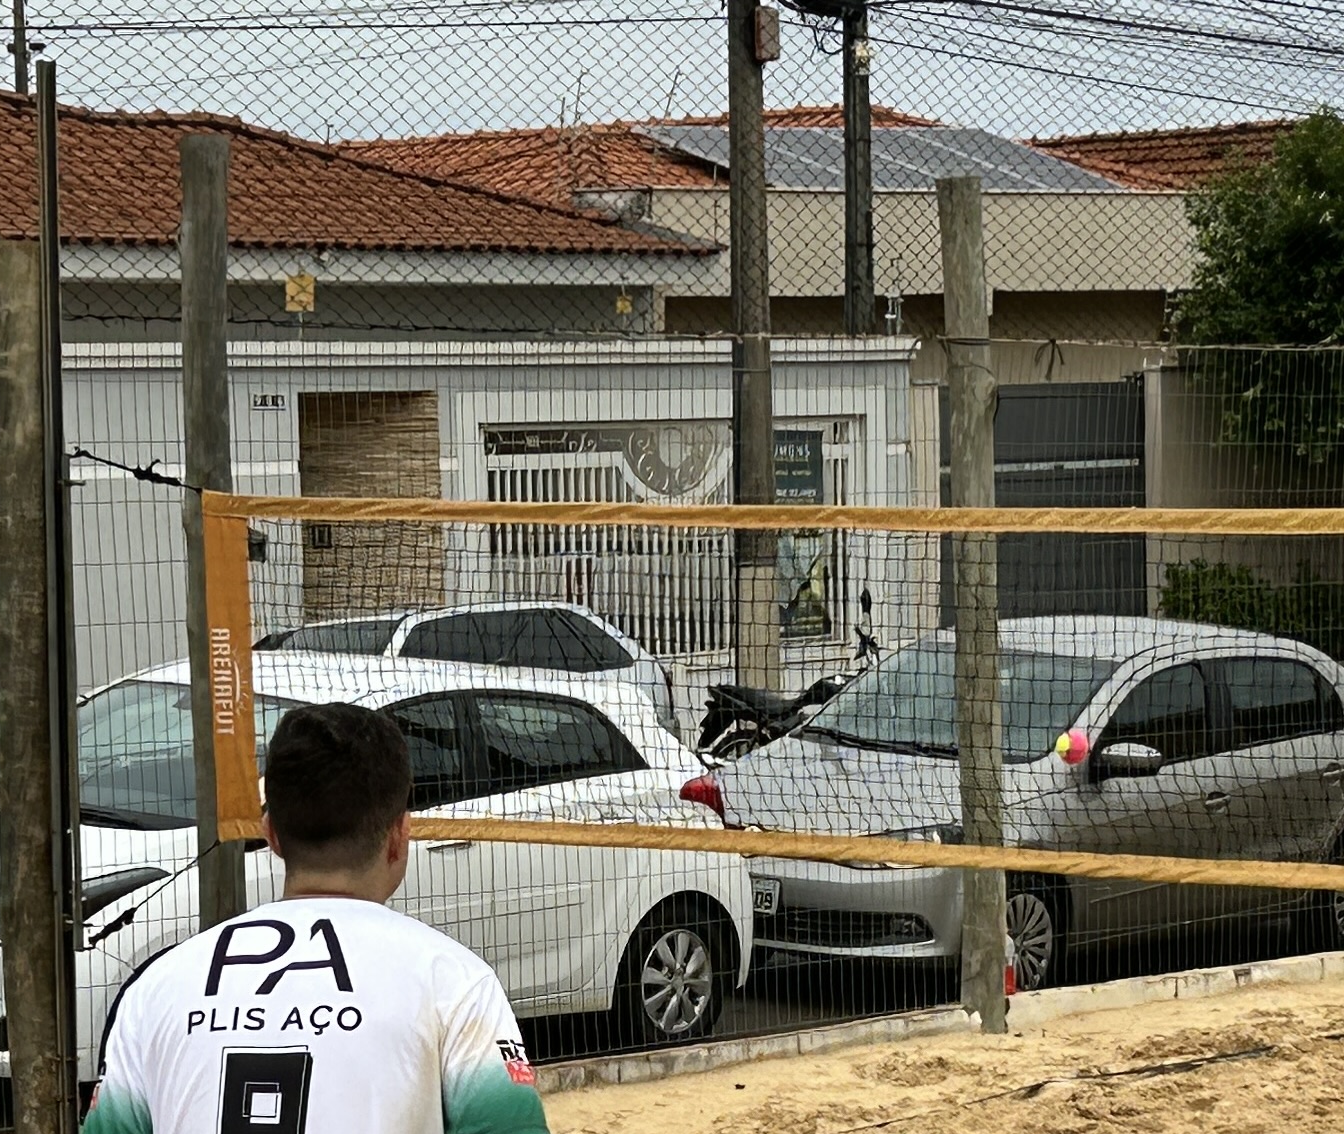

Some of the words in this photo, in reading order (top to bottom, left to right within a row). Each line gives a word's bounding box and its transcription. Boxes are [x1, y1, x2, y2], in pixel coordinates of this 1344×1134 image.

[211, 627, 235, 735] ARENAFUT
[204, 918, 354, 997] PA
[187, 1006, 266, 1035] PLIS
[280, 1005, 363, 1036] AÇO
